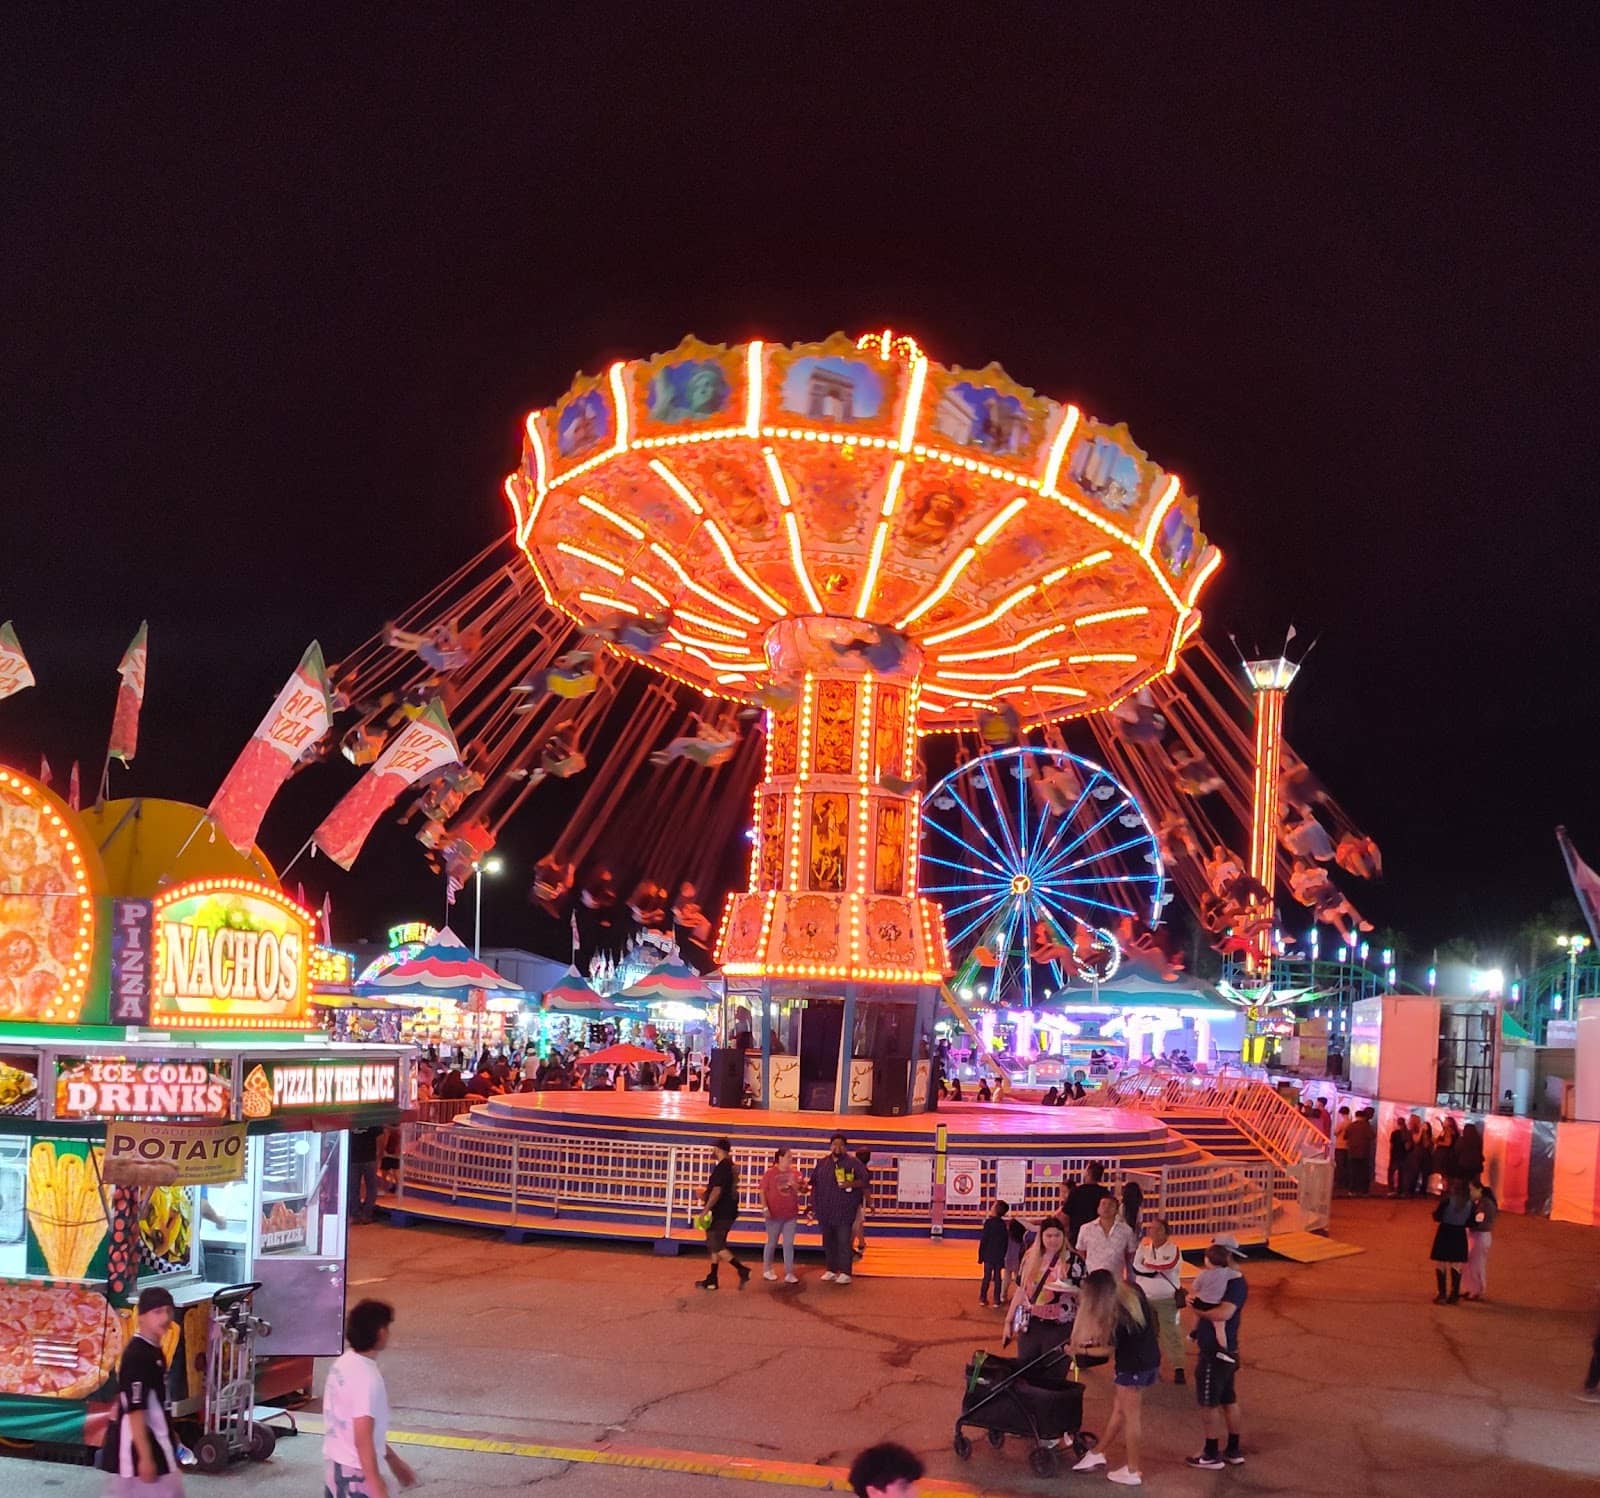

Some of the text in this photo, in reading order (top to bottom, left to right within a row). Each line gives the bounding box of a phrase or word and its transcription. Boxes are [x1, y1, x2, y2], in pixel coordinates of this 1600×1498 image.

[284, 689, 326, 719] HOT
[269, 710, 314, 747] IZZA
[400, 728, 447, 752] HOT
[384, 750, 432, 772] IZZA
[118, 904, 147, 1018] PIZZA
[163, 922, 300, 1001] NACHOS
[91, 1063, 208, 1084] ICE COLD
[273, 1066, 314, 1105] PIZZA
[315, 1065, 335, 1104] BY
[334, 1065, 361, 1102] THE
[361, 1064, 396, 1101] SLICE
[67, 1082, 224, 1113] DRINKS
[112, 1135, 241, 1160] POTATO
[261, 1228, 304, 1248] PRETZEL
